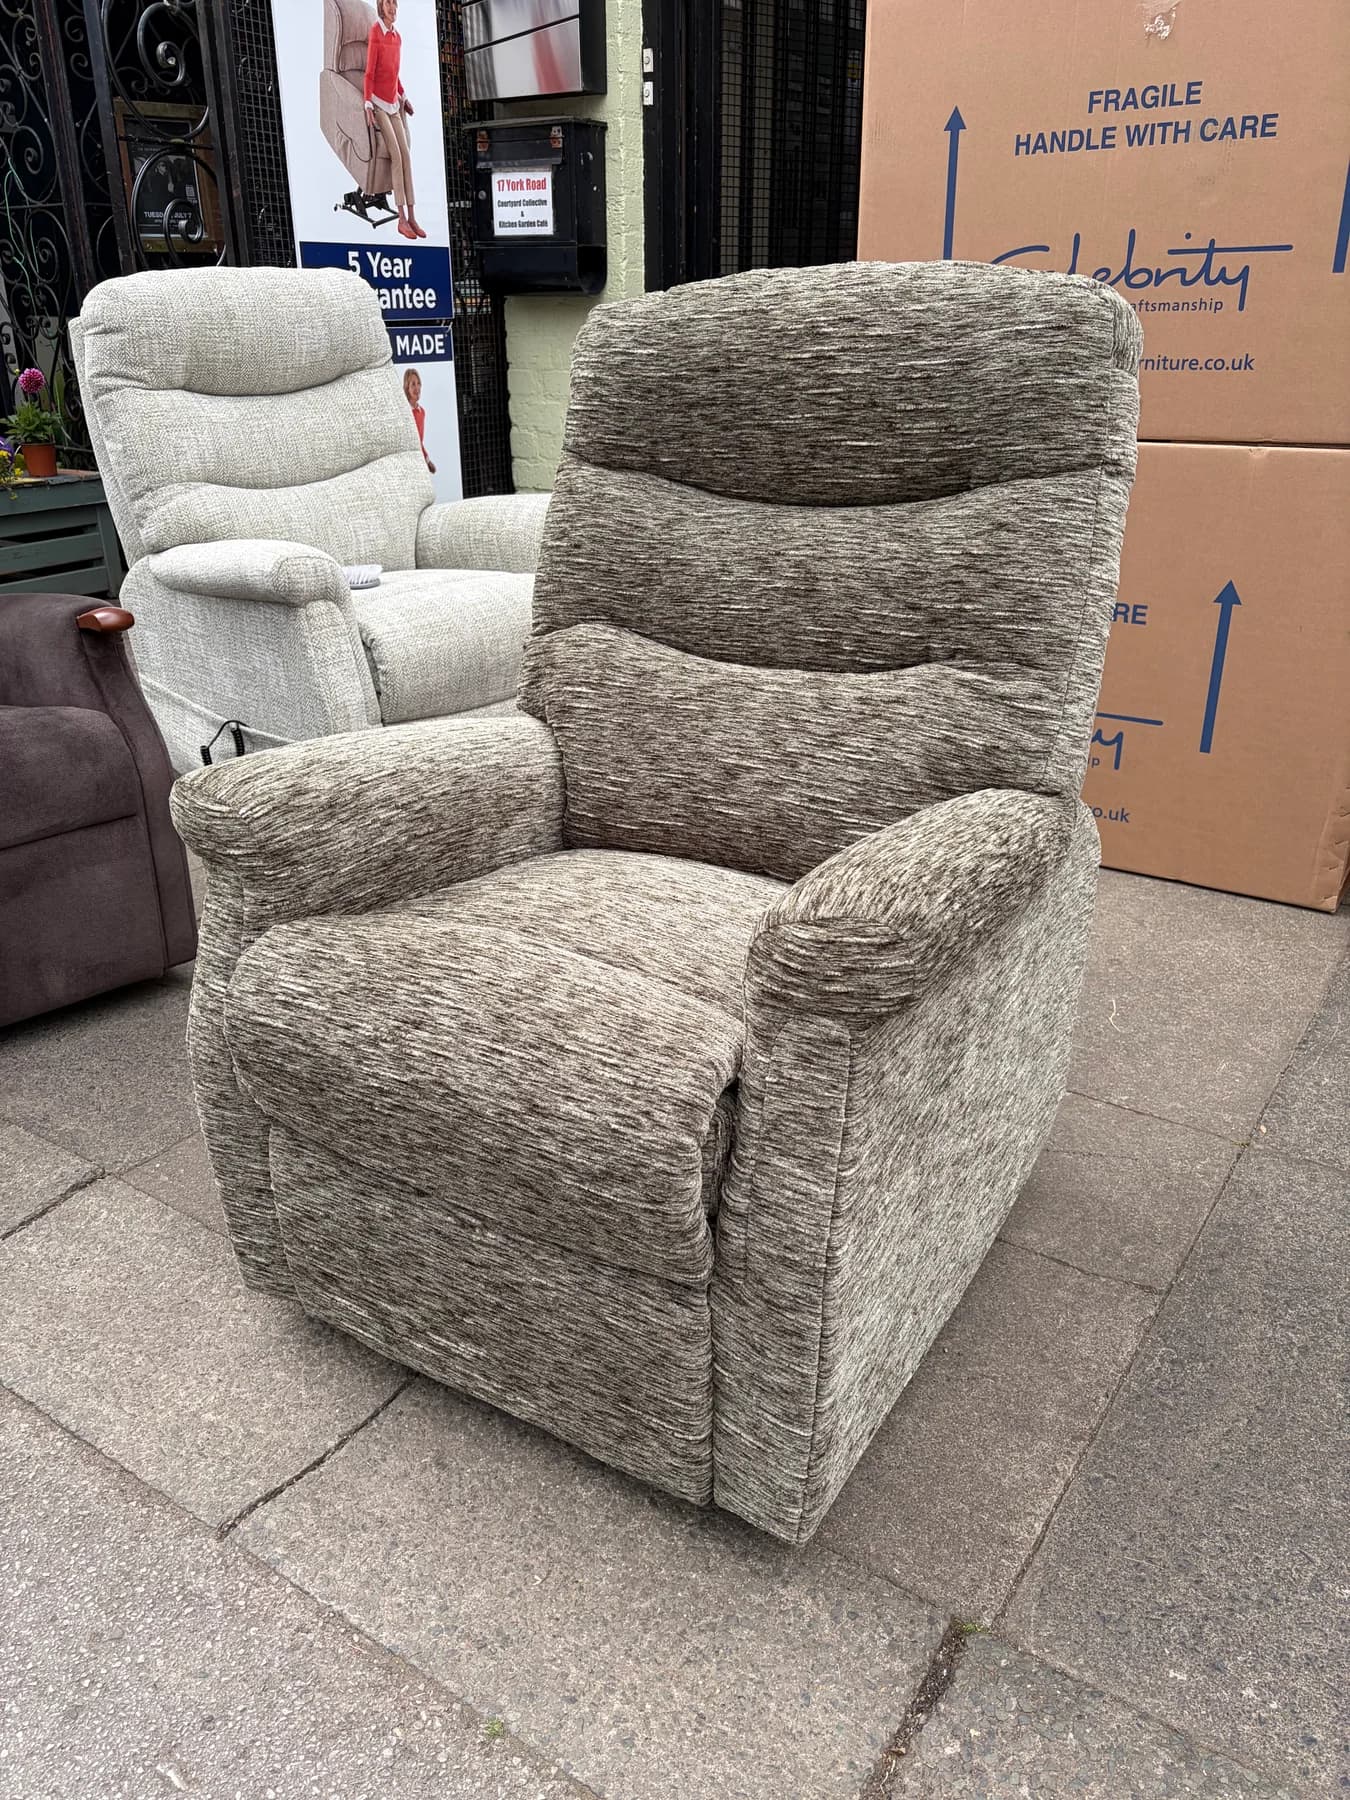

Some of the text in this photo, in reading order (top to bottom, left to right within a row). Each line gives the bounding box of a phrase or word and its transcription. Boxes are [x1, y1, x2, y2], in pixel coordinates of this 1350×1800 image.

[1087, 80, 1203, 114] FRAGILE
[1014, 113, 1279, 157] HANDLE WITH CARE
[497, 177, 547, 192] 17 York Road
[497, 198, 548, 208] Courtyard Collective
[499, 220, 517, 228] Kitchen
[518, 220, 536, 228] Garden
[348, 251, 413, 278] 5 Year
[990, 228, 1294, 313] lebrity
[376, 283, 437, 309] antee
[396, 334, 445, 356] MADE
